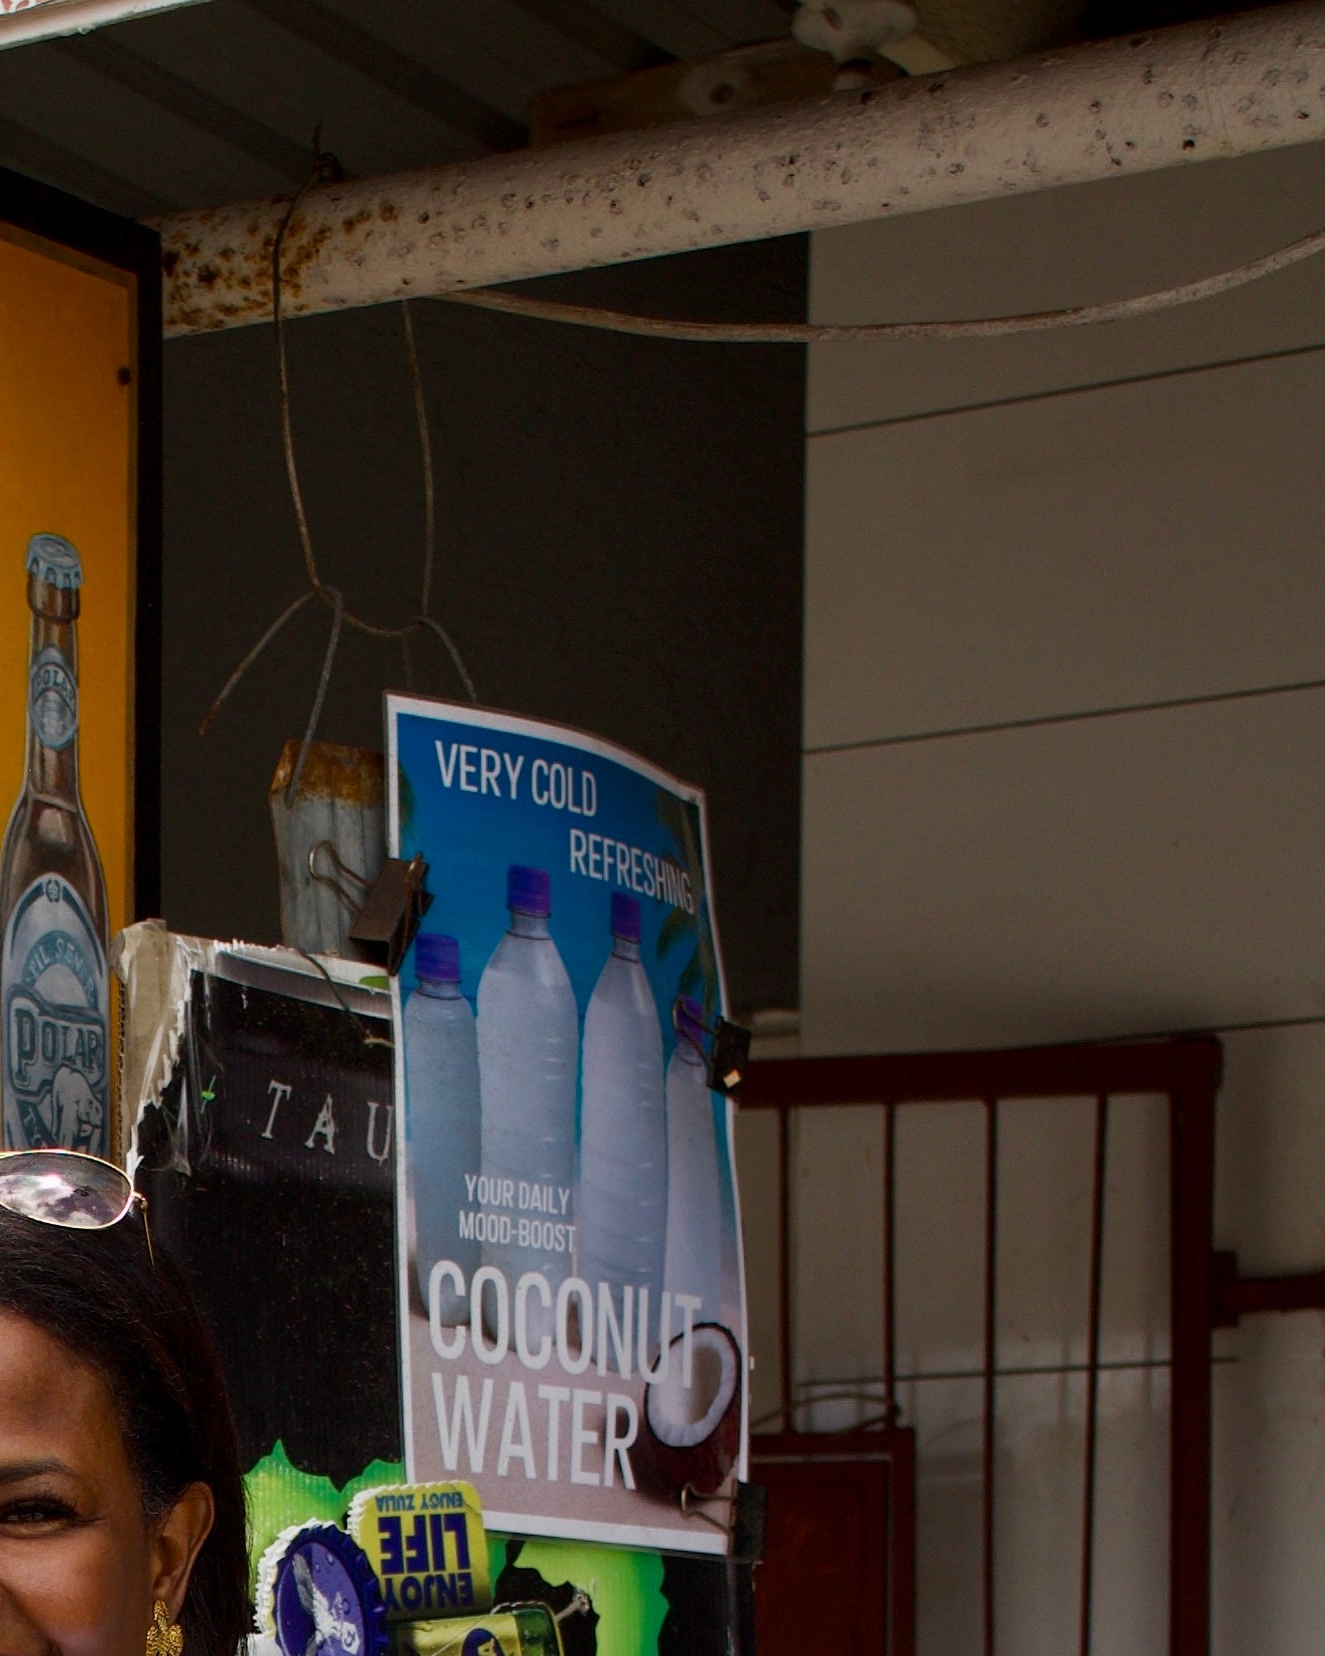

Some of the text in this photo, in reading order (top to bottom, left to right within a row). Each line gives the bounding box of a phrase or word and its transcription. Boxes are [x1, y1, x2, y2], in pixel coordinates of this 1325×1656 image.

[434, 739, 598, 818] VERY COLD
[570, 828, 696, 916] REFRESHING
[14, 1007, 103, 1086] POLAR
[464, 1173, 571, 1216] YOUR DAILY
[458, 1210, 577, 1253] MOOD-BOOST
[427, 1260, 703, 1390] COCONUT
[430, 1370, 640, 1491] WATER
[376, 1491, 464, 1511] ENJOY ZULIA
[377, 1512, 471, 1576] LIFE
[383, 1572, 474, 1612] ENJOY
